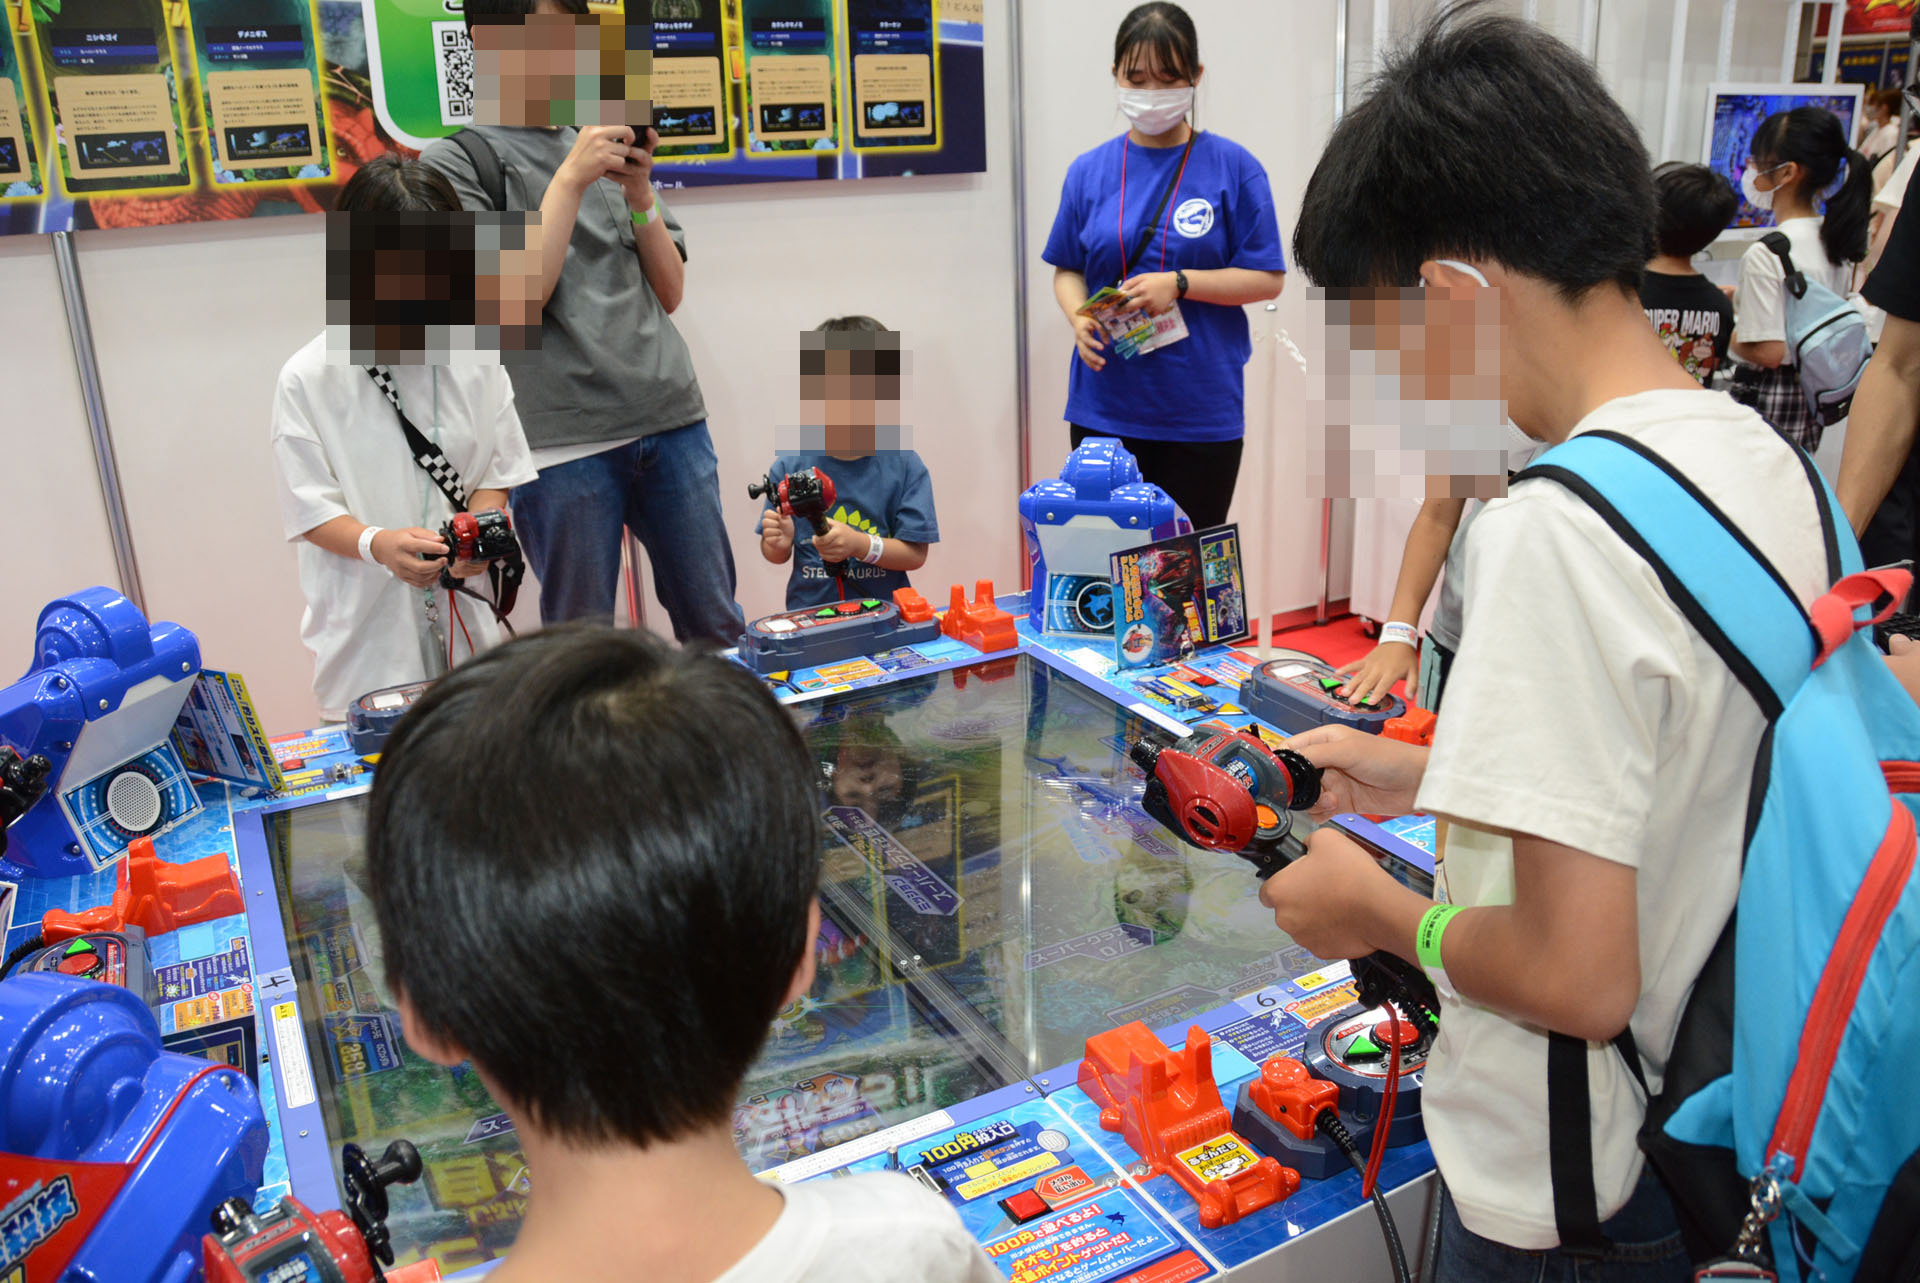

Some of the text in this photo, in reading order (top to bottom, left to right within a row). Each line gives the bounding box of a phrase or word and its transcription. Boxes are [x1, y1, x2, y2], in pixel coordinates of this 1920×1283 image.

[1681, 310, 1720, 336] MARIO
[802, 565, 887, 580] STEAURUS
[1030, 925, 1132, 965] スーパークラス
[1256, 992, 1277, 1008] 6
[920, 1123, 1015, 1163] 100円投入口
[1049, 1174, 1073, 1187] メダル
[984, 1202, 1104, 1258] 100円で遊べるよ!
[1010, 1227, 1110, 1273] オオモノを釣ると
[1039, 1234, 1159, 1283] になるとゲームオーバーだよ。
